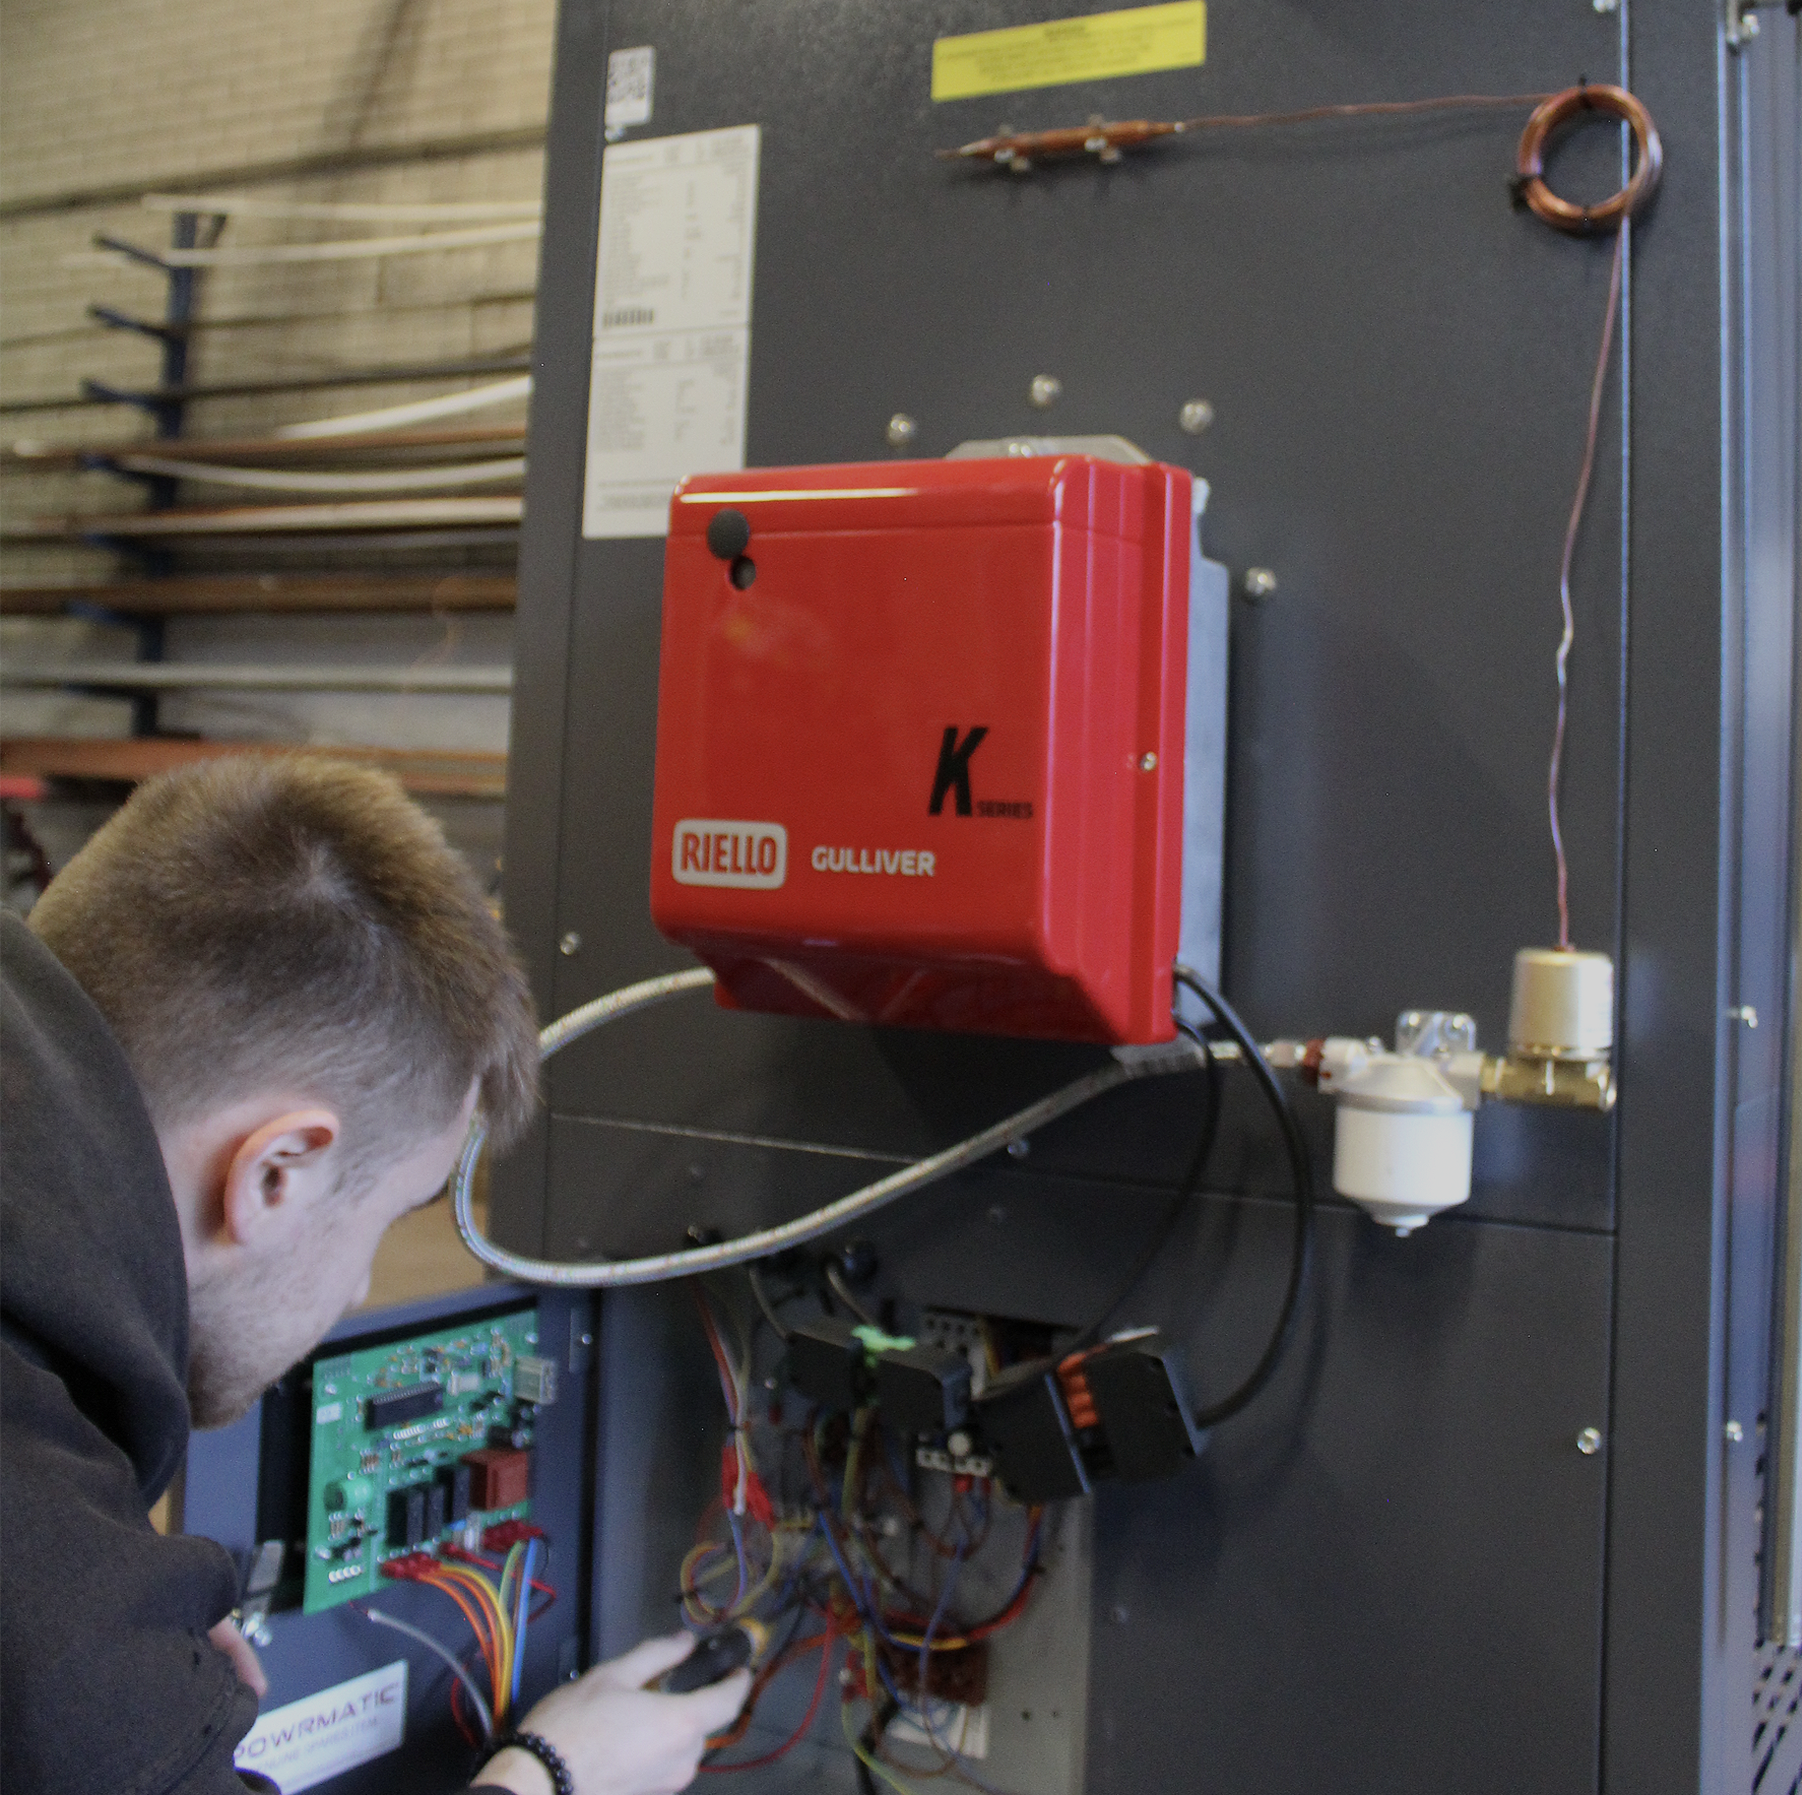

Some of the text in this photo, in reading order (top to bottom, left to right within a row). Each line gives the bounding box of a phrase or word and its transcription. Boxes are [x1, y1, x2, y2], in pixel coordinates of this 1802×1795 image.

[927, 725, 1034, 820] K SERIES
[680, 831, 778, 876] RIELLO
[811, 845, 935, 877] GULLIVER
